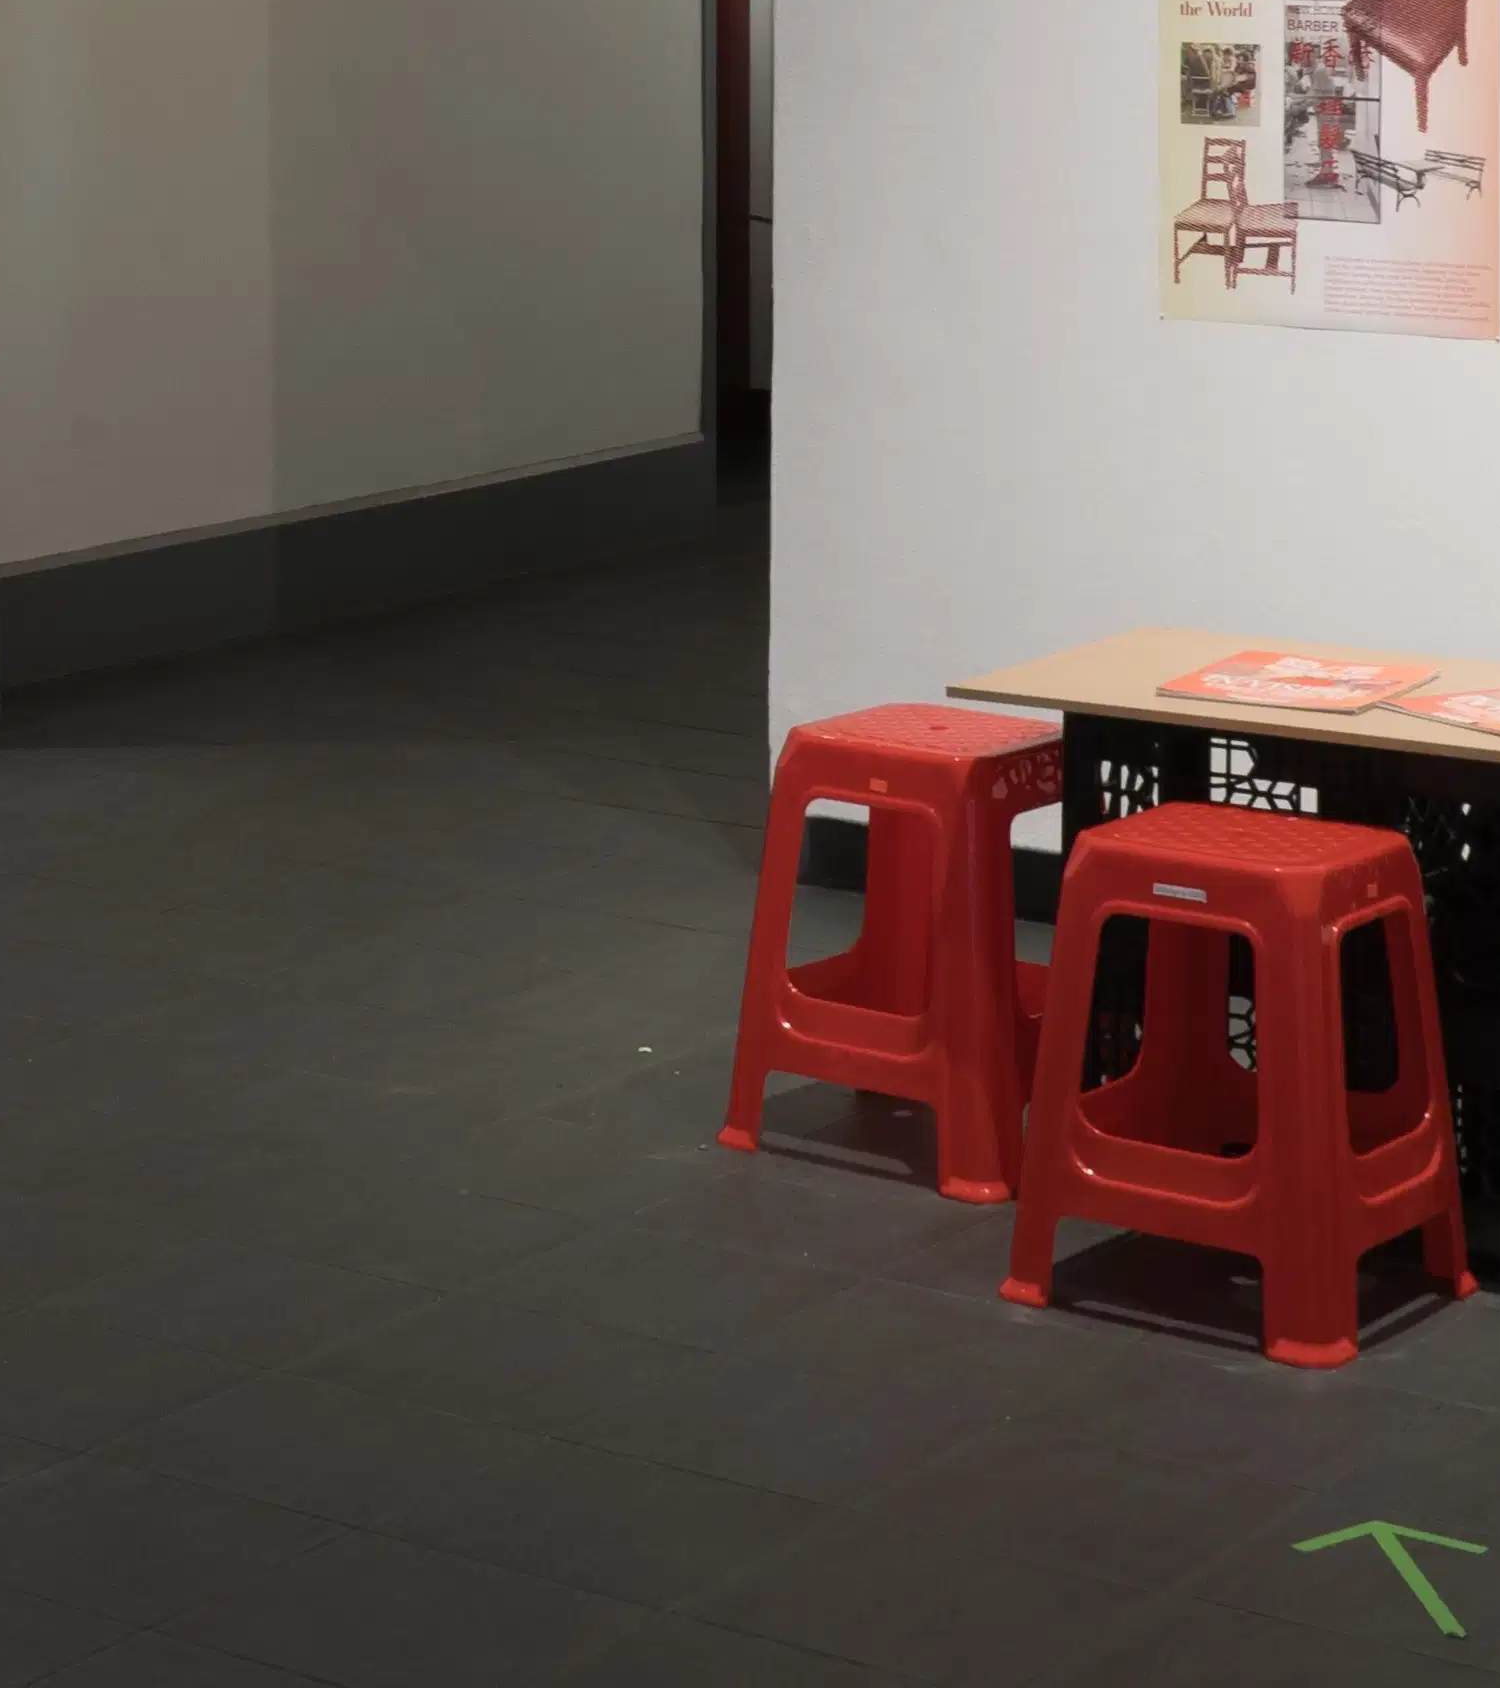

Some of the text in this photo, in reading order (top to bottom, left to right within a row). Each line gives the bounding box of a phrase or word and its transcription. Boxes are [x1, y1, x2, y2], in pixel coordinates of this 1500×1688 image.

[1180, 1, 1254, 18] the World
[1287, 19, 1339, 33] BARBER
